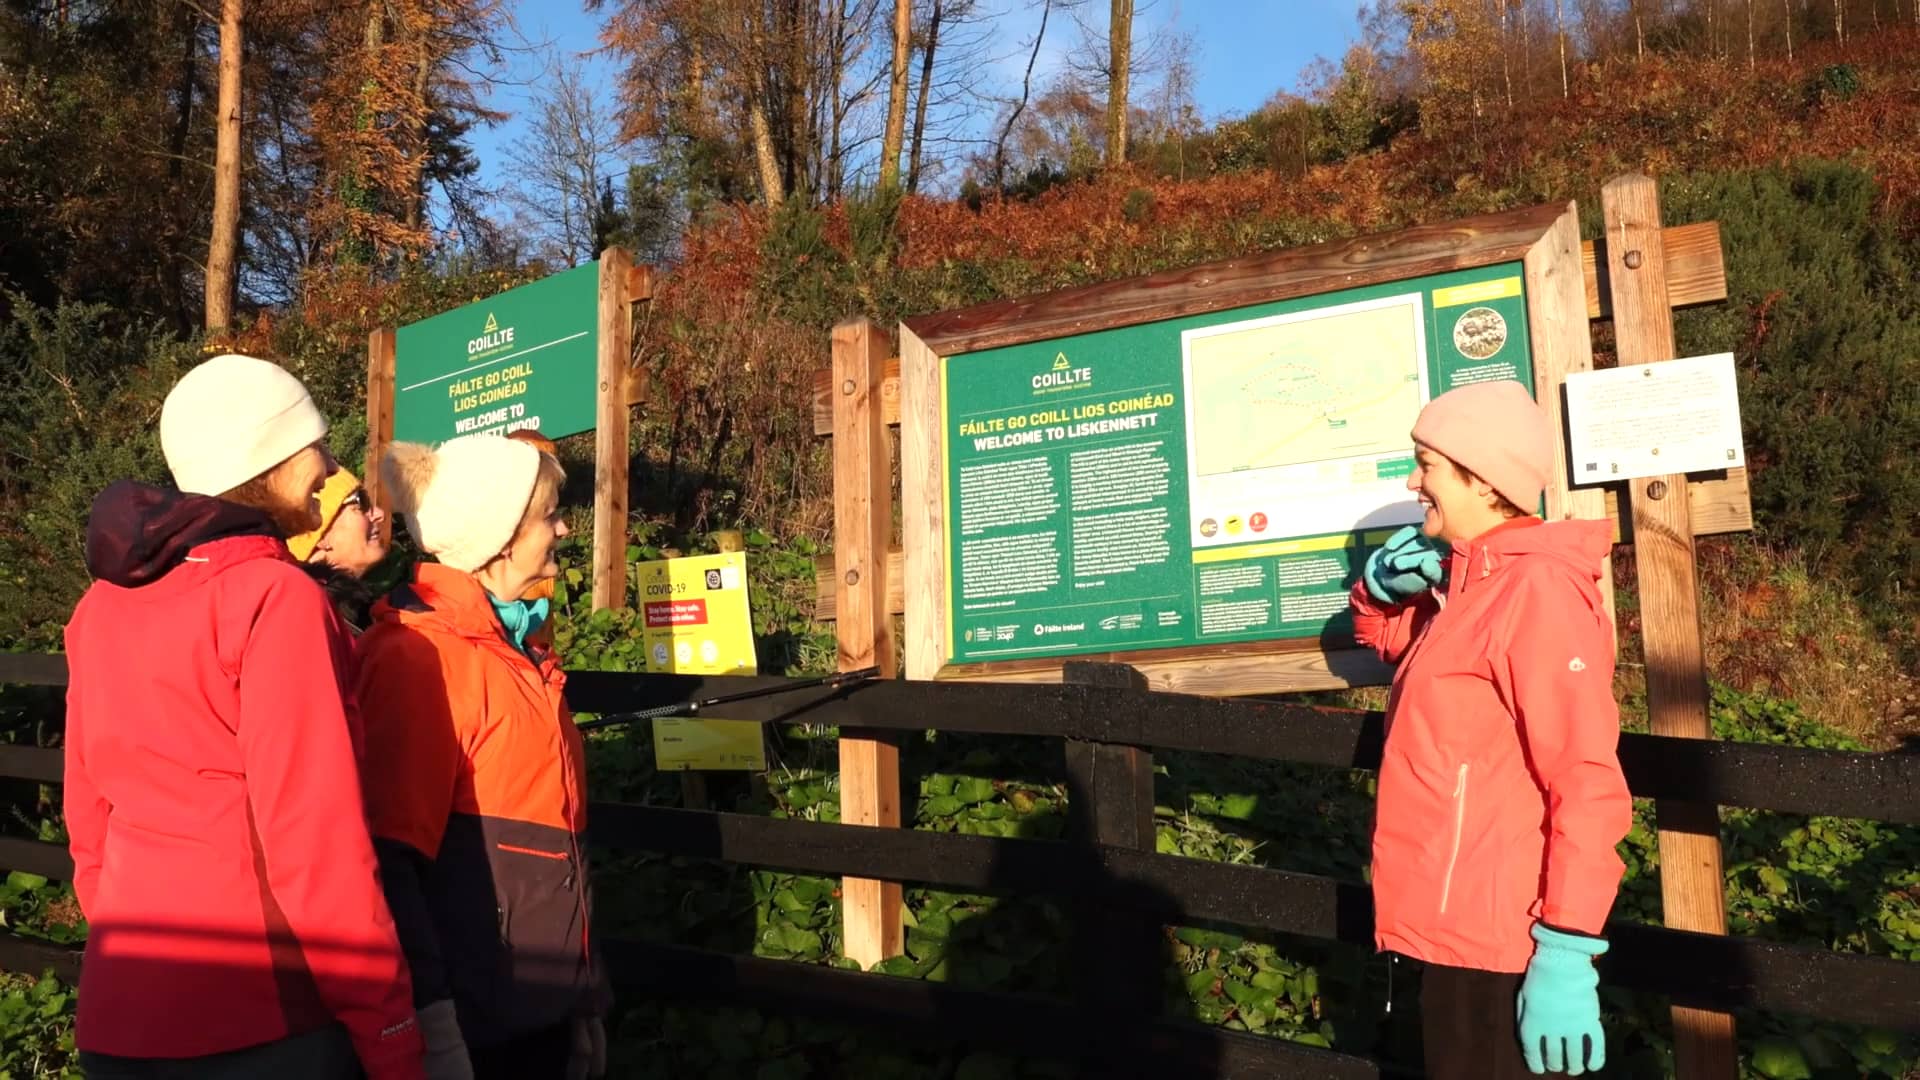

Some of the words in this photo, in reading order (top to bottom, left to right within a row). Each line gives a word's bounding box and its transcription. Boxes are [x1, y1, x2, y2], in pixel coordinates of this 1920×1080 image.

[468, 328, 514, 354] COILLTE
[449, 376, 483, 398] FÁILTE
[486, 371, 500, 387] GO
[502, 362, 533, 382] COILL
[1032, 367, 1092, 389] COILLTE
[454, 395, 477, 413] LIOS
[479, 381, 527, 408] COINÉAD
[455, 407, 508, 434] WELCOME
[510, 403, 525, 419] TO
[960, 419, 1005, 436] FÁILTE
[1007, 416, 1027, 429] GO
[1029, 410, 1069, 425] COILL
[1073, 403, 1105, 419] LIOS
[1108, 392, 1174, 414] COINÉAD
[974, 430, 1043, 451] WELCOME
[1045, 427, 1065, 441] TO
[1067, 413, 1158, 438] LISKENNETT
[646, 583, 686, 596] COVID-19
